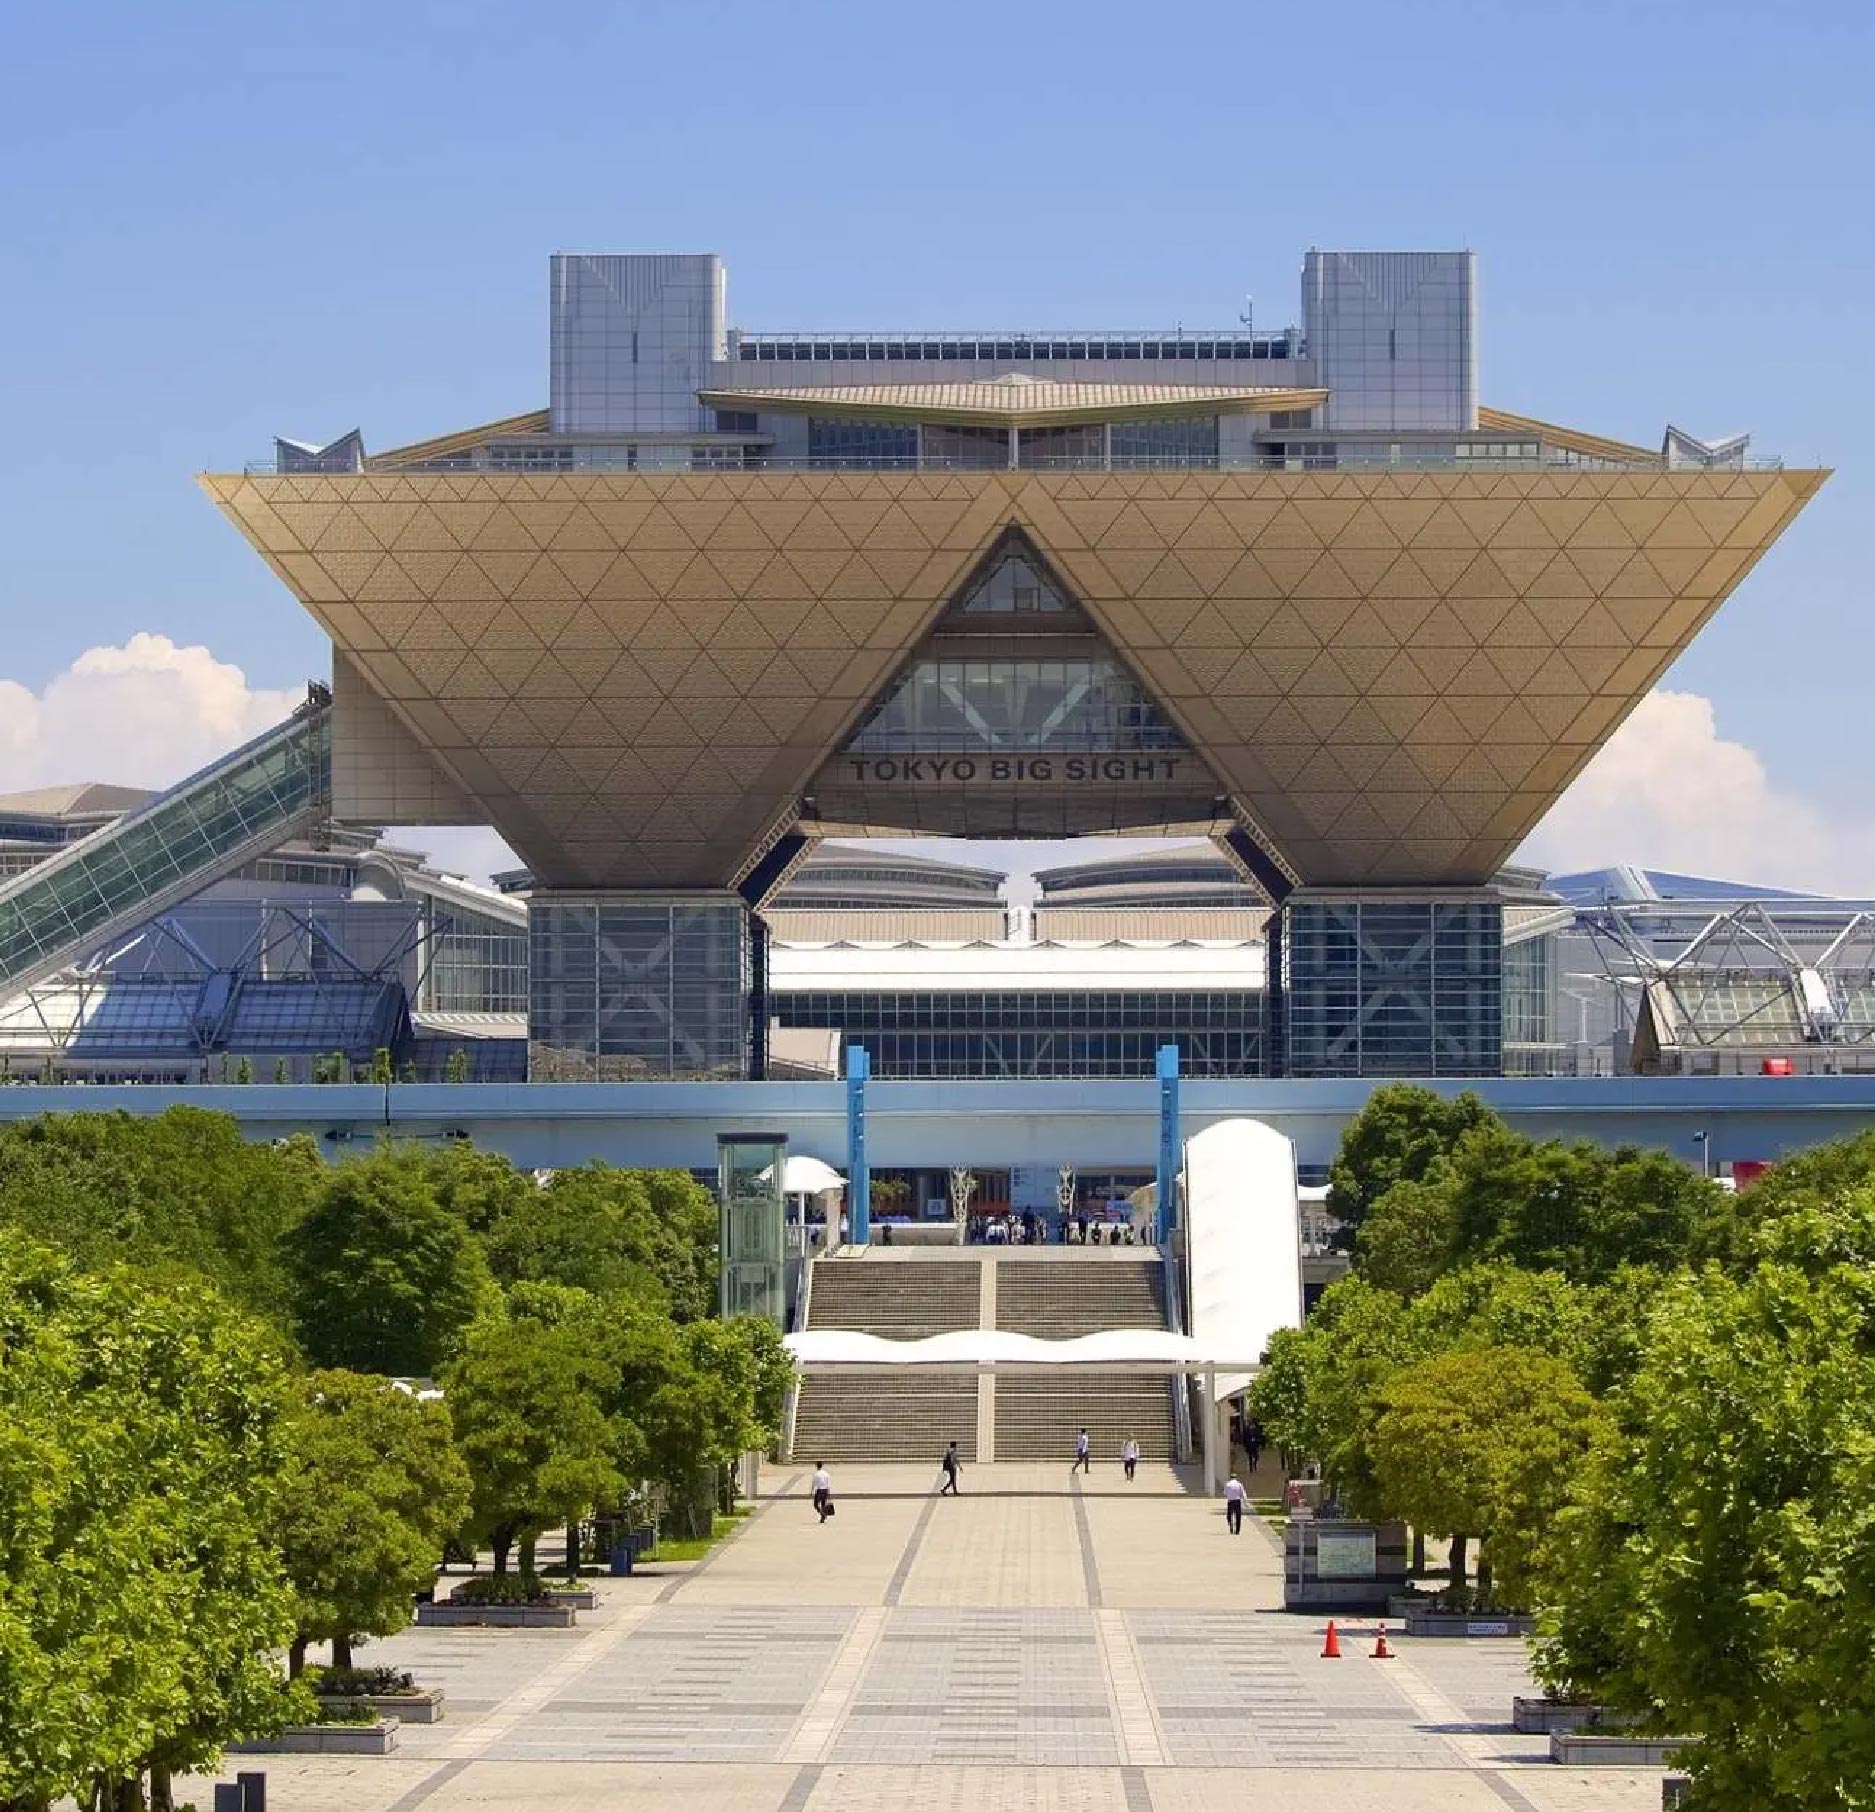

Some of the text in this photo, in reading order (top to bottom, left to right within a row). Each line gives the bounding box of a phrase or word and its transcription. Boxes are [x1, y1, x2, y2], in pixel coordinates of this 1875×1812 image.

[850, 758, 1182, 781] TOKYO BIG SIGHT
